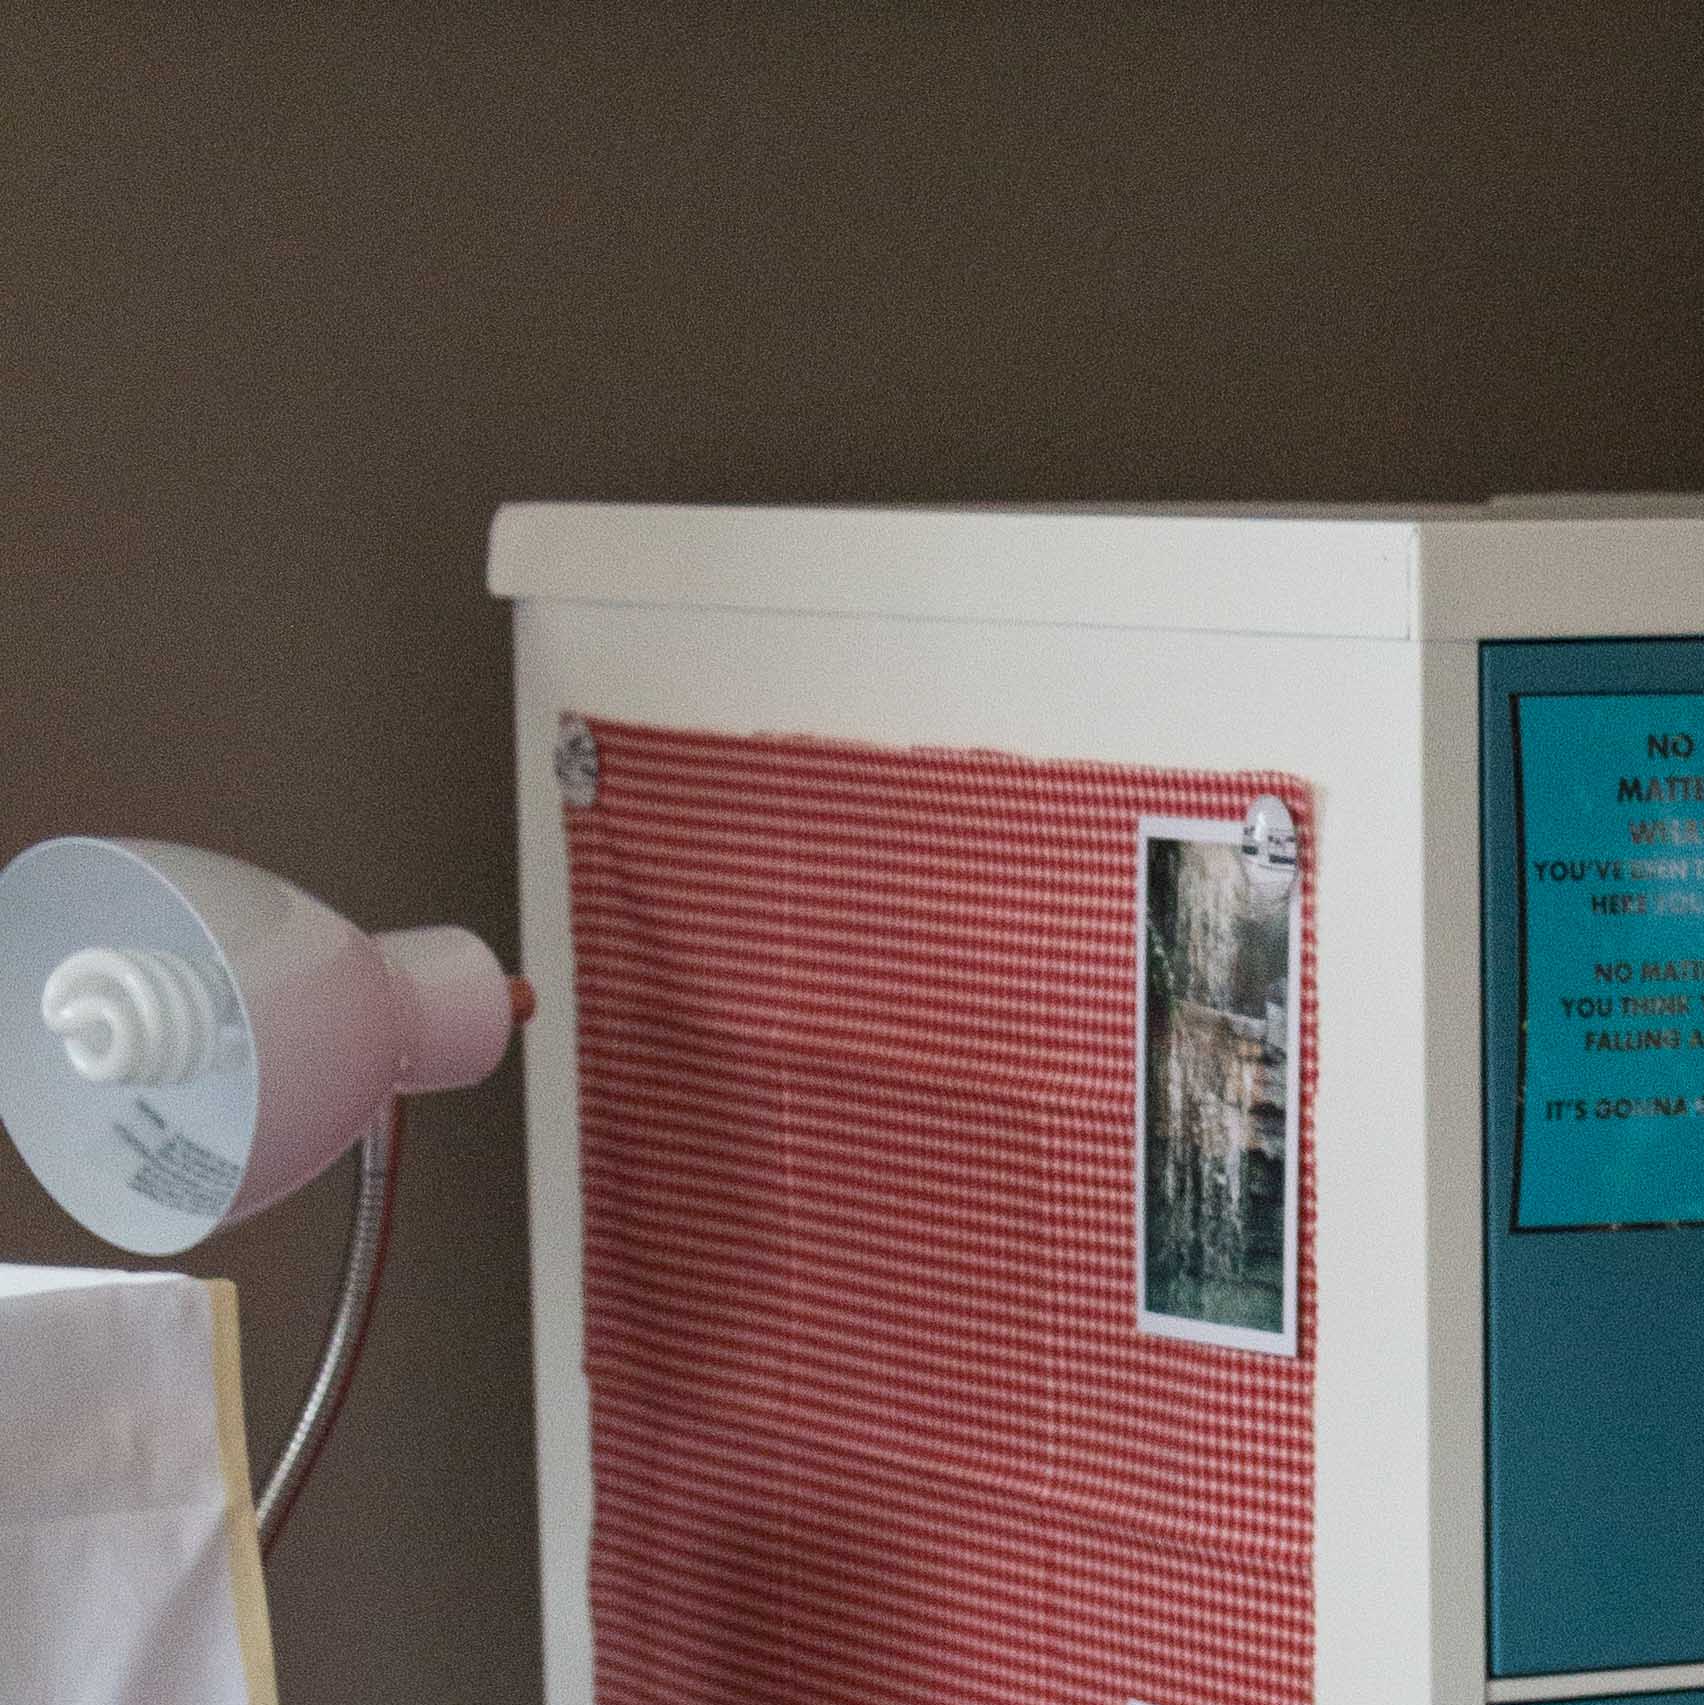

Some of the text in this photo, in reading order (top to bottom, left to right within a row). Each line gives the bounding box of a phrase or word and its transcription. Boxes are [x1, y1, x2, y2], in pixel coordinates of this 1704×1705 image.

[1648, 733, 1694, 759] NO
[1535, 859, 1622, 882] YOU'VE
[1591, 894, 1646, 914] HERE
[1594, 963, 1632, 983] NO
[1560, 997, 1612, 1018] YOU
[1621, 996, 1688, 1016] THINK
[1585, 1029, 1680, 1051] FALLING
[1546, 1099, 1587, 1120] IT'S
[1596, 1097, 1686, 1119] GONNA
